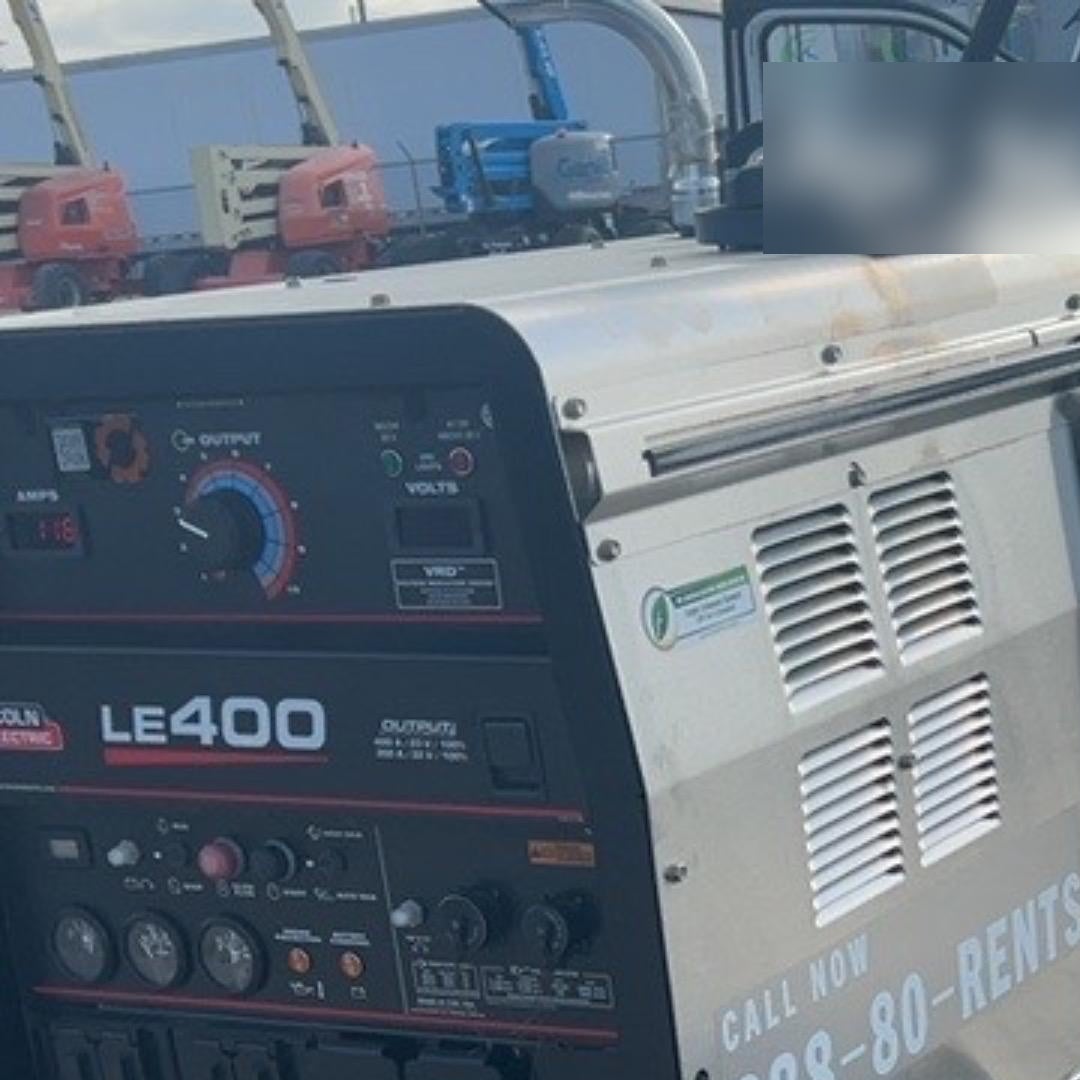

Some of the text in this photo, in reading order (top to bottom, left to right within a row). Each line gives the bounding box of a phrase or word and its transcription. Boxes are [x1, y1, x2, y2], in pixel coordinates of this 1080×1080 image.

[200, 431, 261, 447] OUTPUT
[17, 489, 59, 502] AMPS
[404, 481, 460, 496] VOLTS
[101, 695, 327, 751] LE400
[721, 933, 870, 1051] CALL NOW
